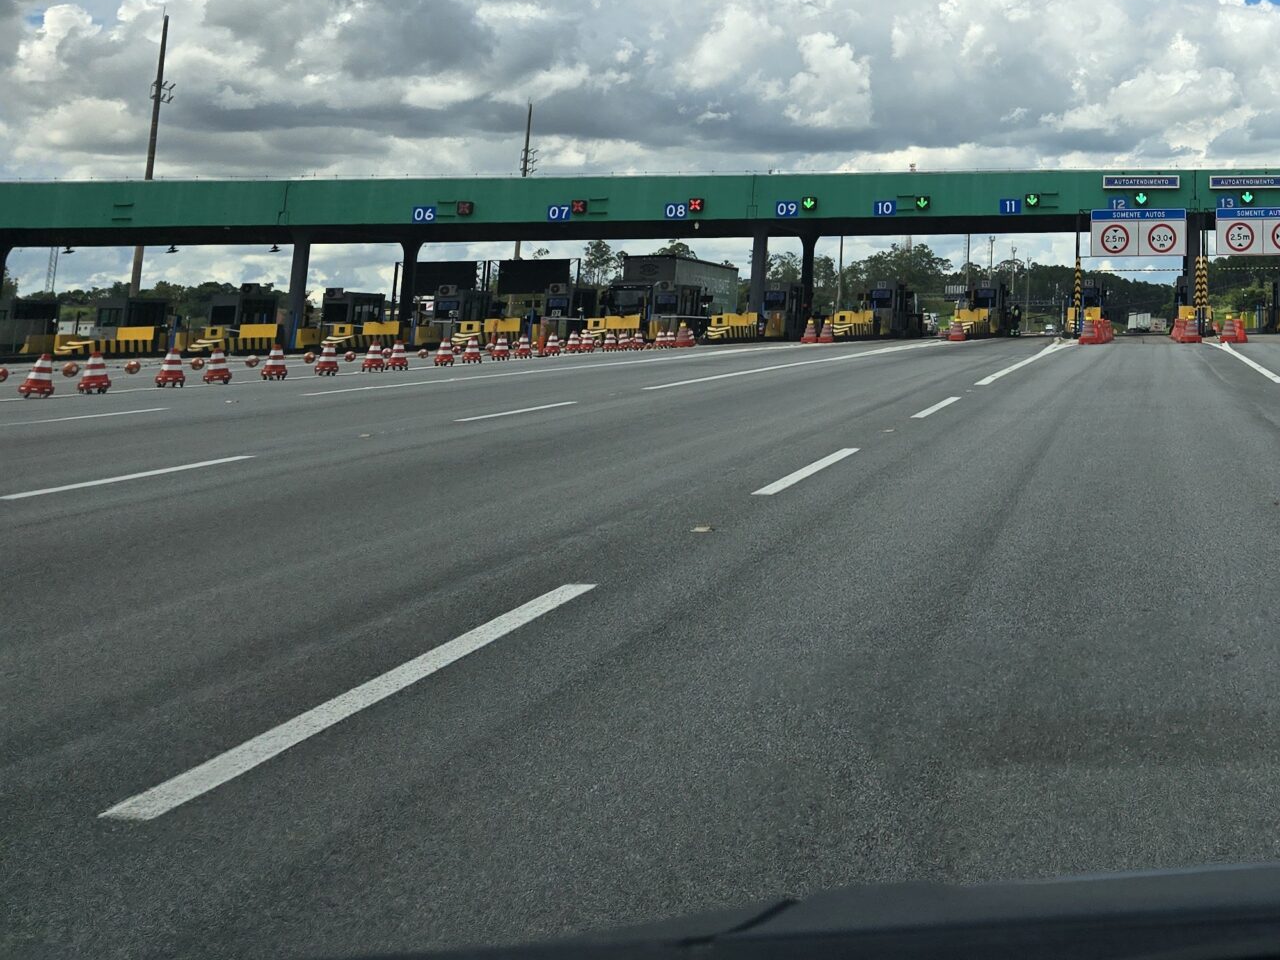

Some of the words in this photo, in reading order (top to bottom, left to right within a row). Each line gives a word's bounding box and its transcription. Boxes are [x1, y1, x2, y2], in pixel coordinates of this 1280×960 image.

[777, 203, 797, 215] 09
[877, 201, 892, 214] 10
[1005, 200, 1016, 213] 11
[1112, 199, 1126, 209] 12
[1221, 198, 1234, 208] 13
[414, 208, 434, 221] 06
[549, 206, 569, 219] 07
[666, 204, 686, 217] 08
